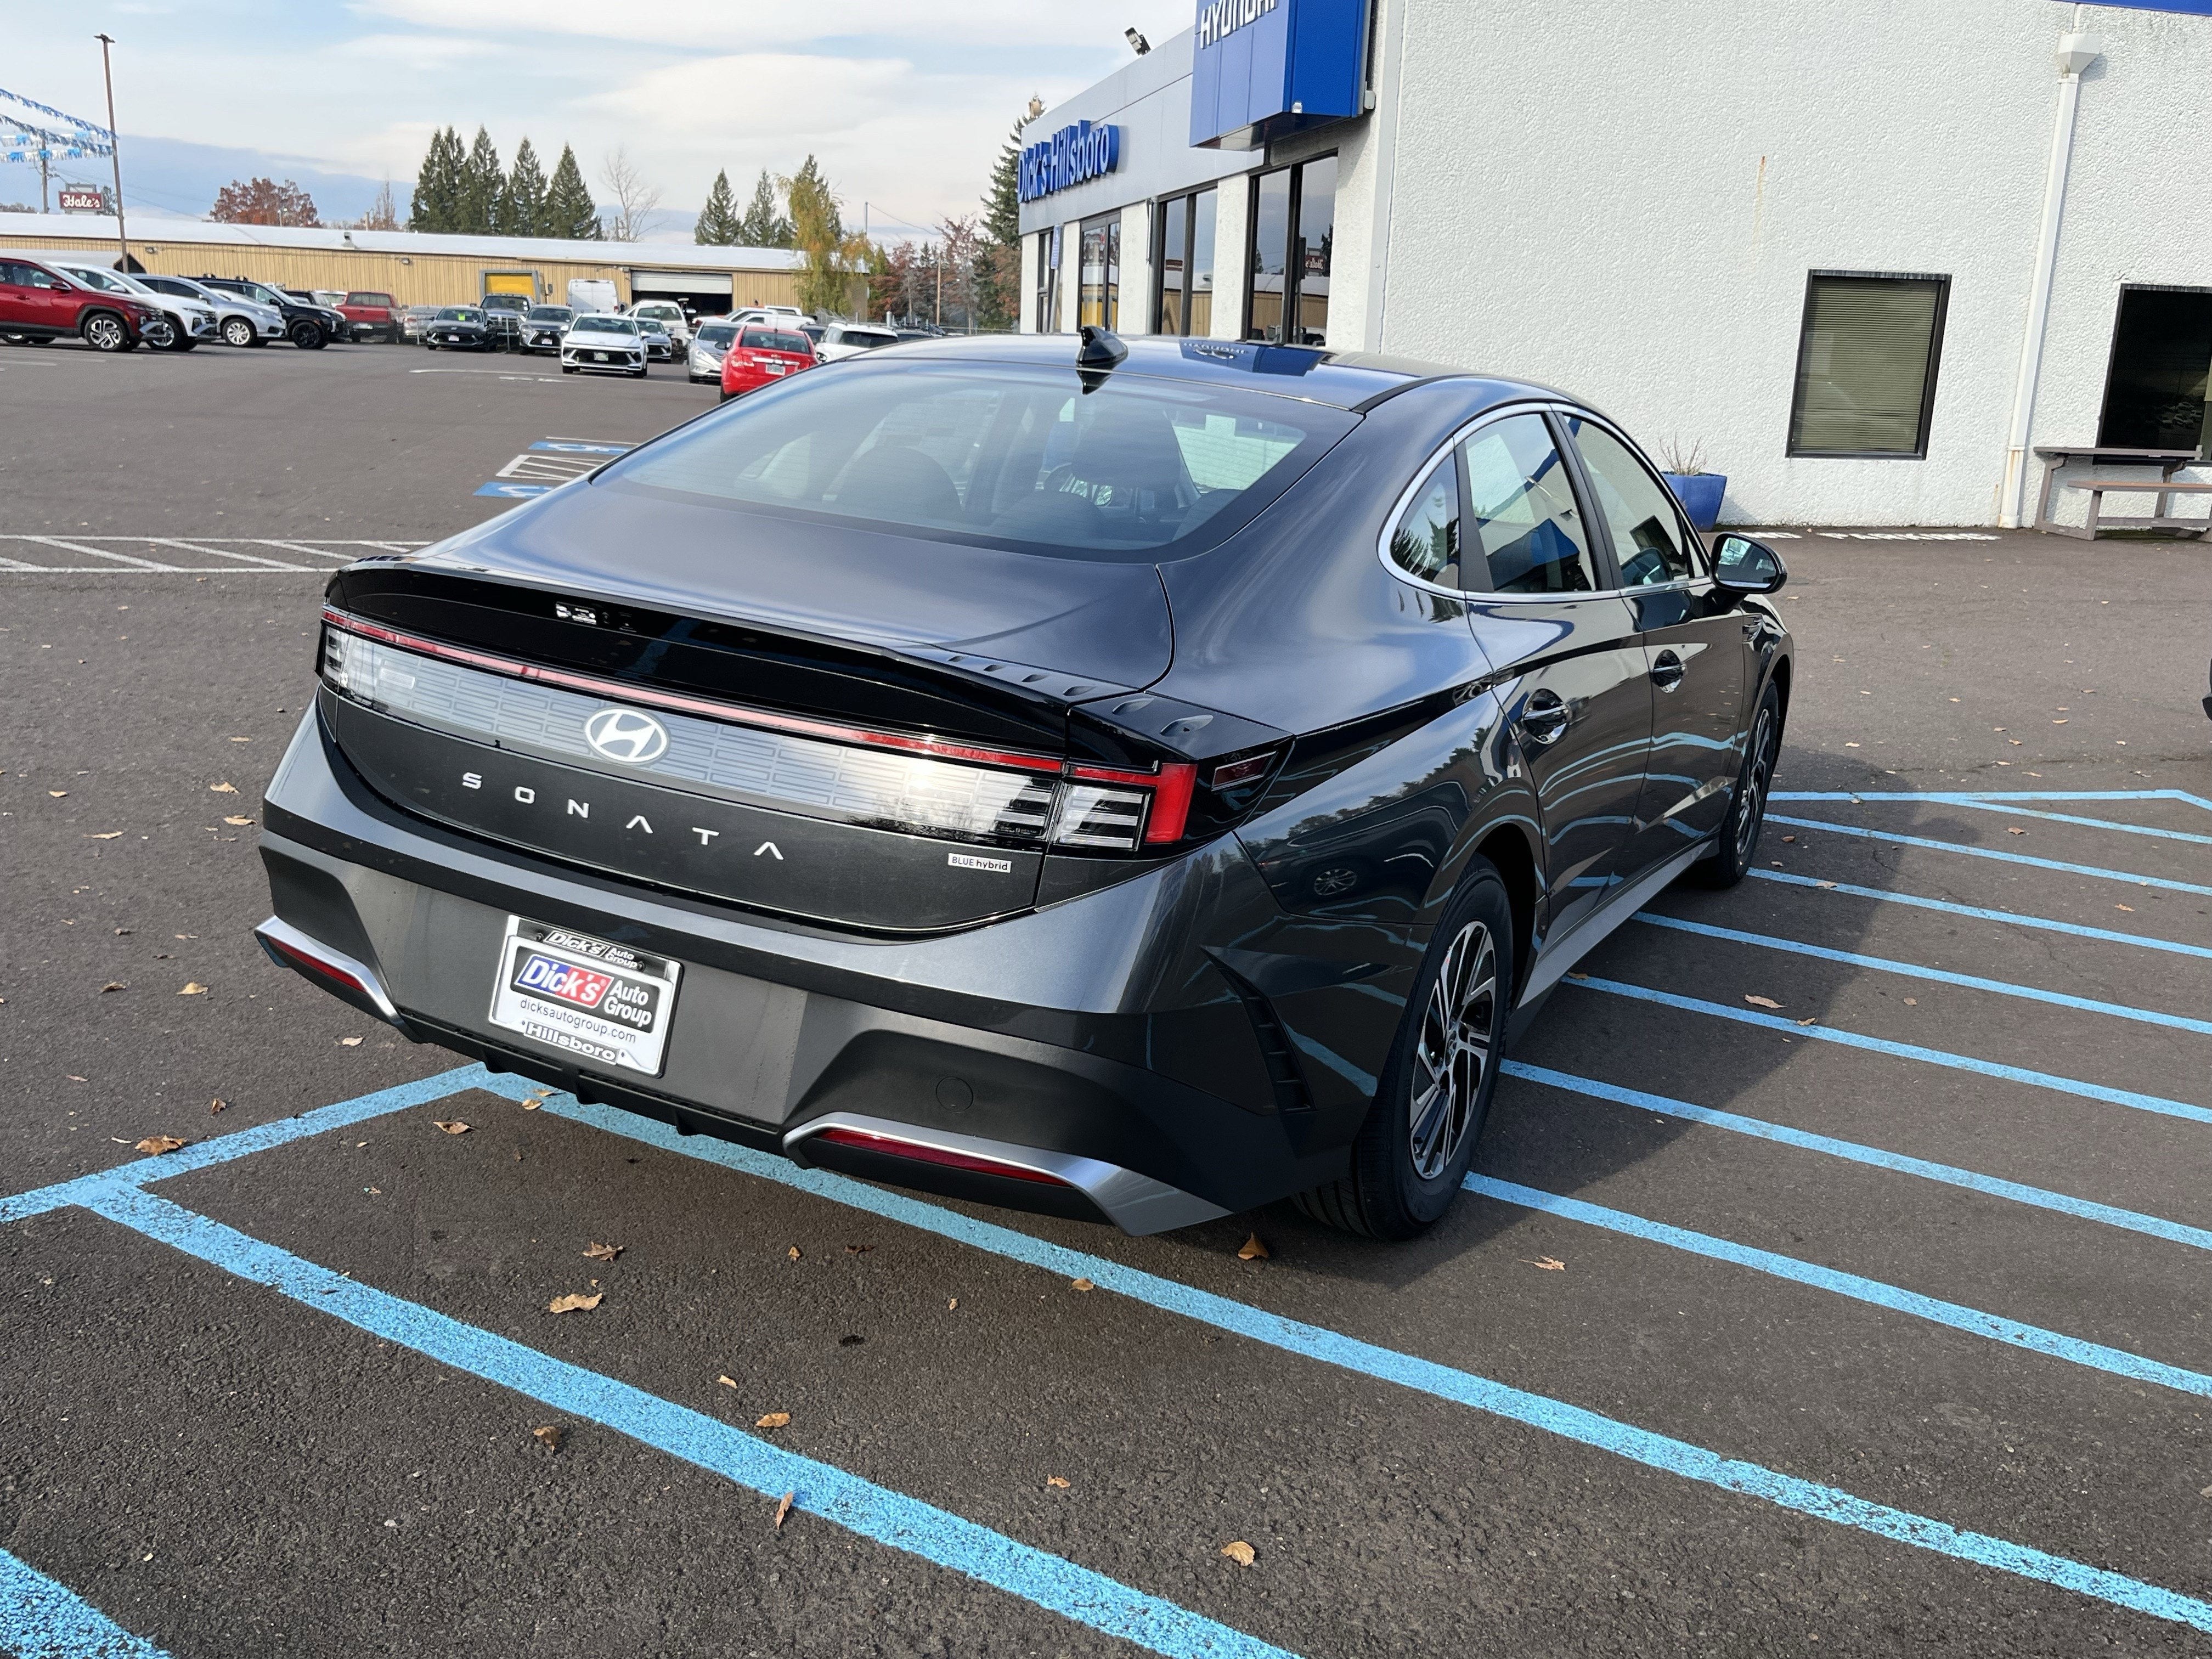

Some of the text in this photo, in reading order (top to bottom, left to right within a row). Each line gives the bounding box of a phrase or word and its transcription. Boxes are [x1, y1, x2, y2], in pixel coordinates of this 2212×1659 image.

[1200, 0, 1277, 49] HYUND
[1017, 120, 1111, 204] Dick's Hillsboro
[63, 194, 100, 208] Hale's
[462, 772, 784, 861] SONATA
[952, 856, 1008, 871] BLUE hybrid
[549, 933, 635, 960] Dick's Auto
[605, 952, 638, 970] Group
[522, 959, 648, 1006] Dick's Auto
[520, 998, 636, 1043] dicksautogroup.com
[604, 996, 652, 1028] Group
[527, 1022, 616, 1060] Hillsboro
